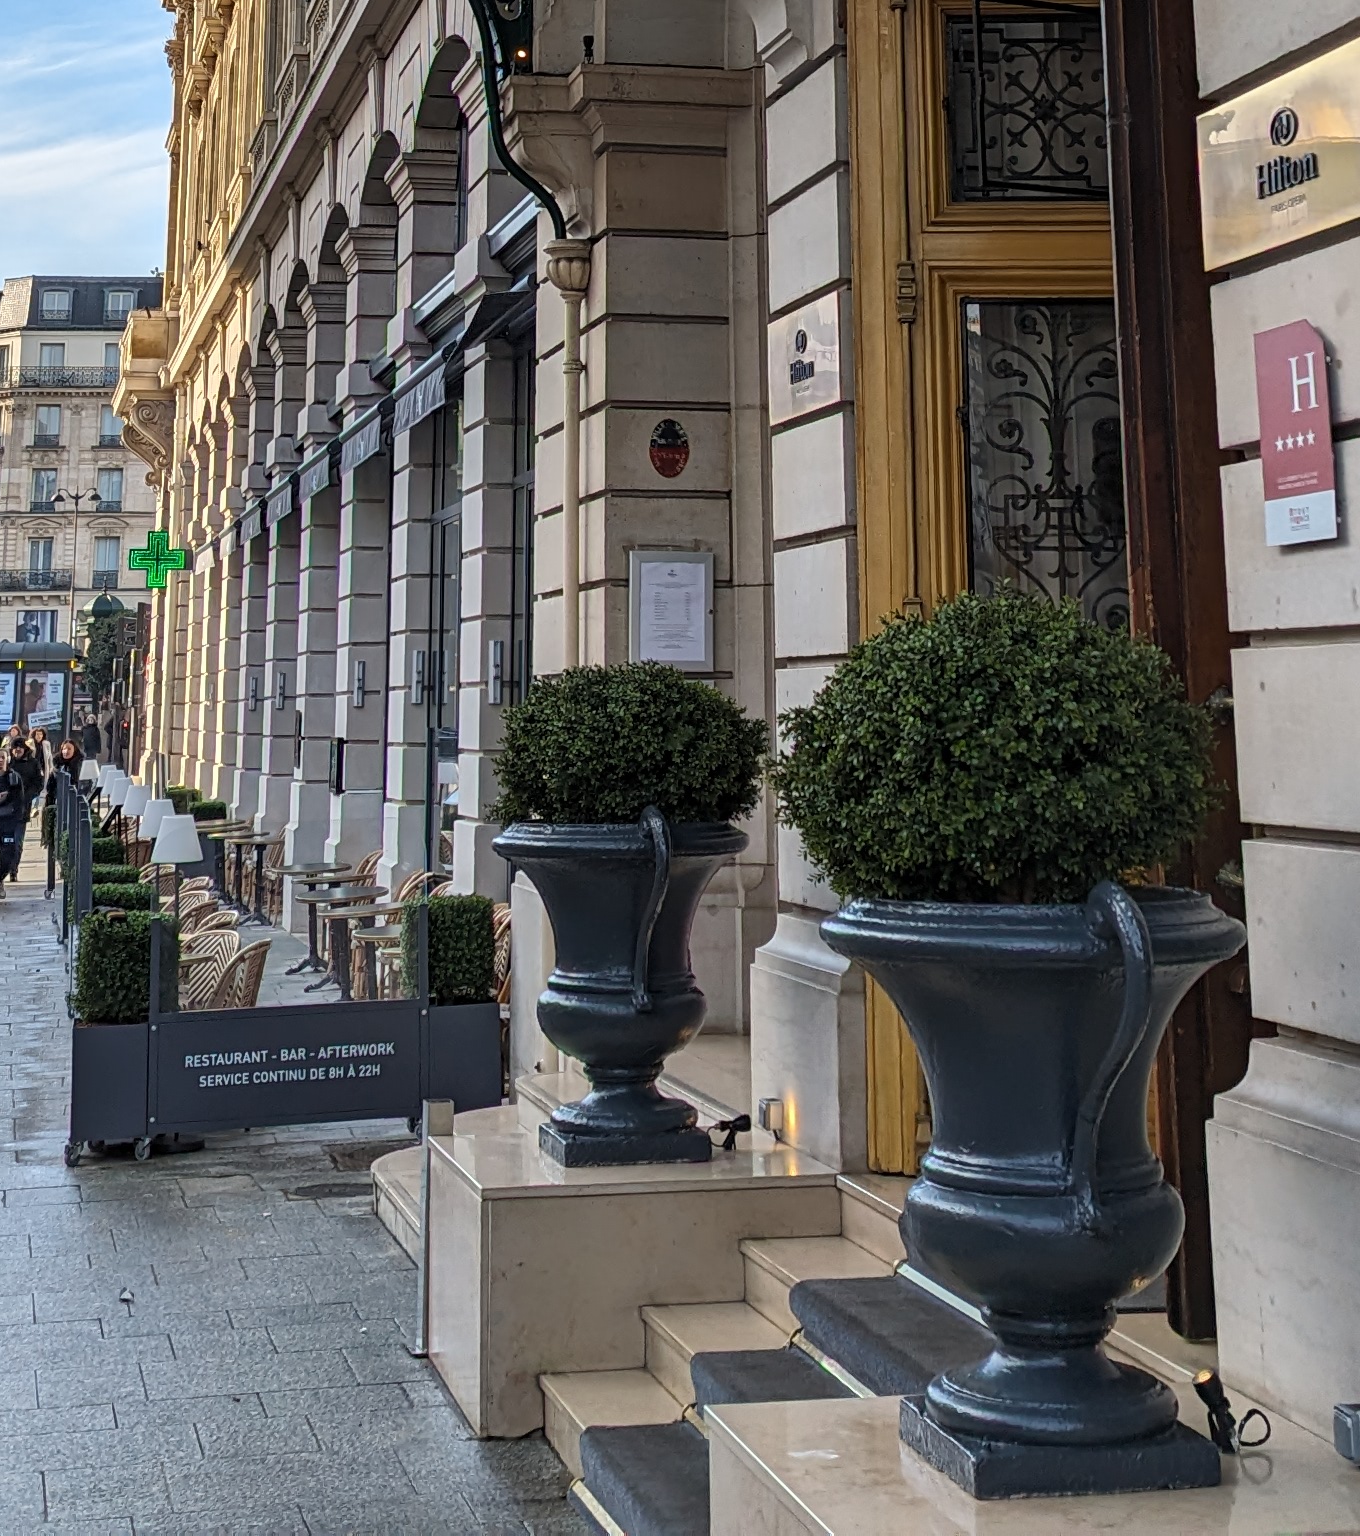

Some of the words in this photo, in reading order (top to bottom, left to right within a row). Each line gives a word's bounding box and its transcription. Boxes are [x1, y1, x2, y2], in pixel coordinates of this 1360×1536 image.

[1256, 152, 1320, 200] Hilton
[1288, 351, 1320, 413] H
[184, 1050, 268, 1068] RESTAURANT
[281, 1047, 306, 1062] BAR
[318, 1042, 395, 1060] AFTERWORK
[199, 1073, 250, 1088] SERVICE
[253, 1068, 307, 1084] CONTINU
[310, 1067, 326, 1080] DE
[329, 1066, 344, 1079] 8H
[346, 1063, 356, 1078] À
[358, 1064, 381, 1077] 22H
